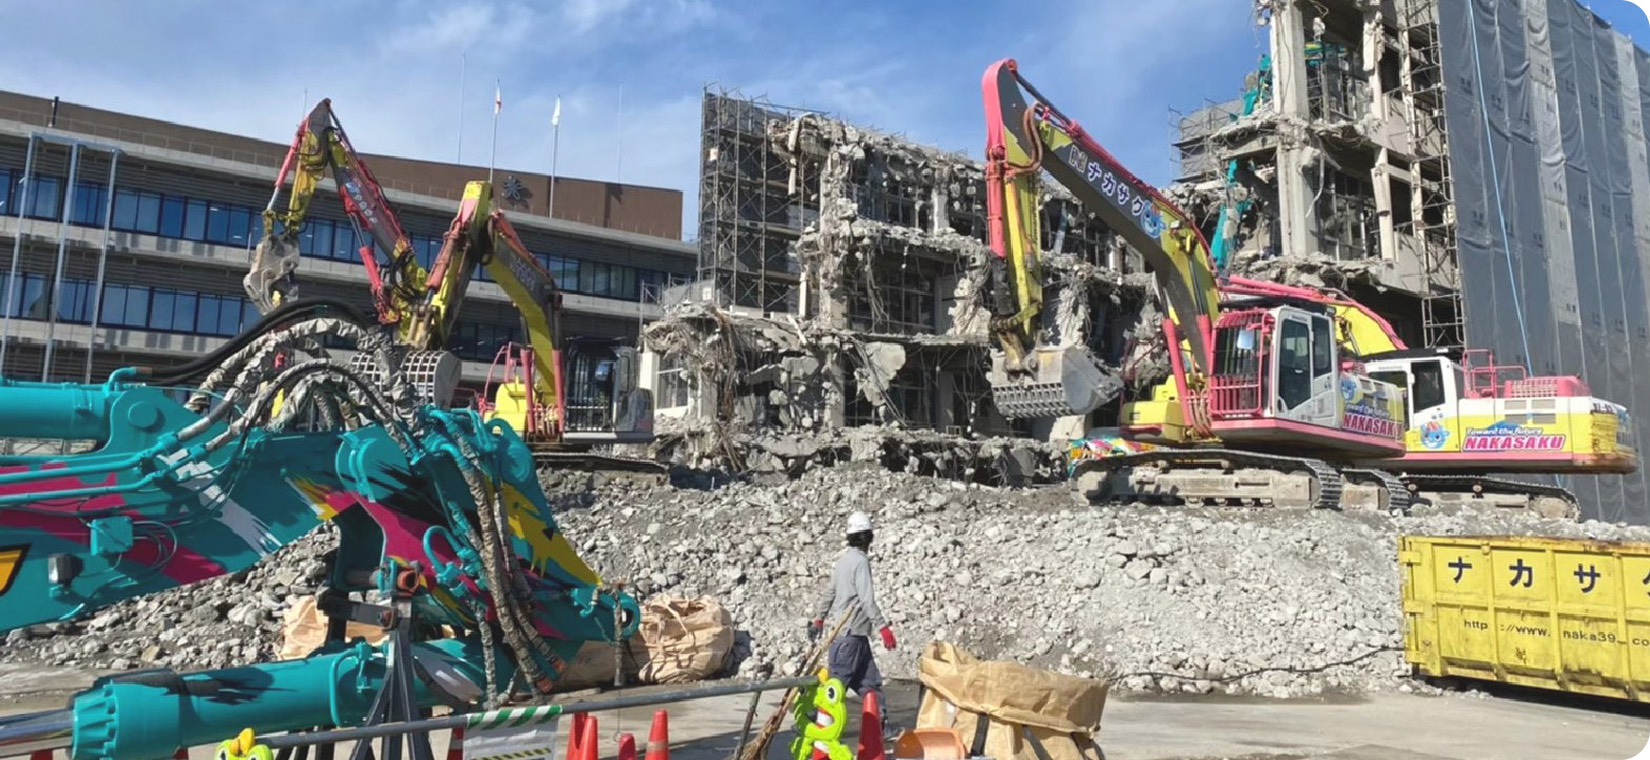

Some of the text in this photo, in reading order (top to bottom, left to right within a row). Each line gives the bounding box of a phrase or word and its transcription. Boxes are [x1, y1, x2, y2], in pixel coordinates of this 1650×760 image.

[1087, 161, 1144, 216] ナカサク
[1464, 436, 1564, 450] NAKASAKU
[1448, 556, 1650, 597] ナカサ
